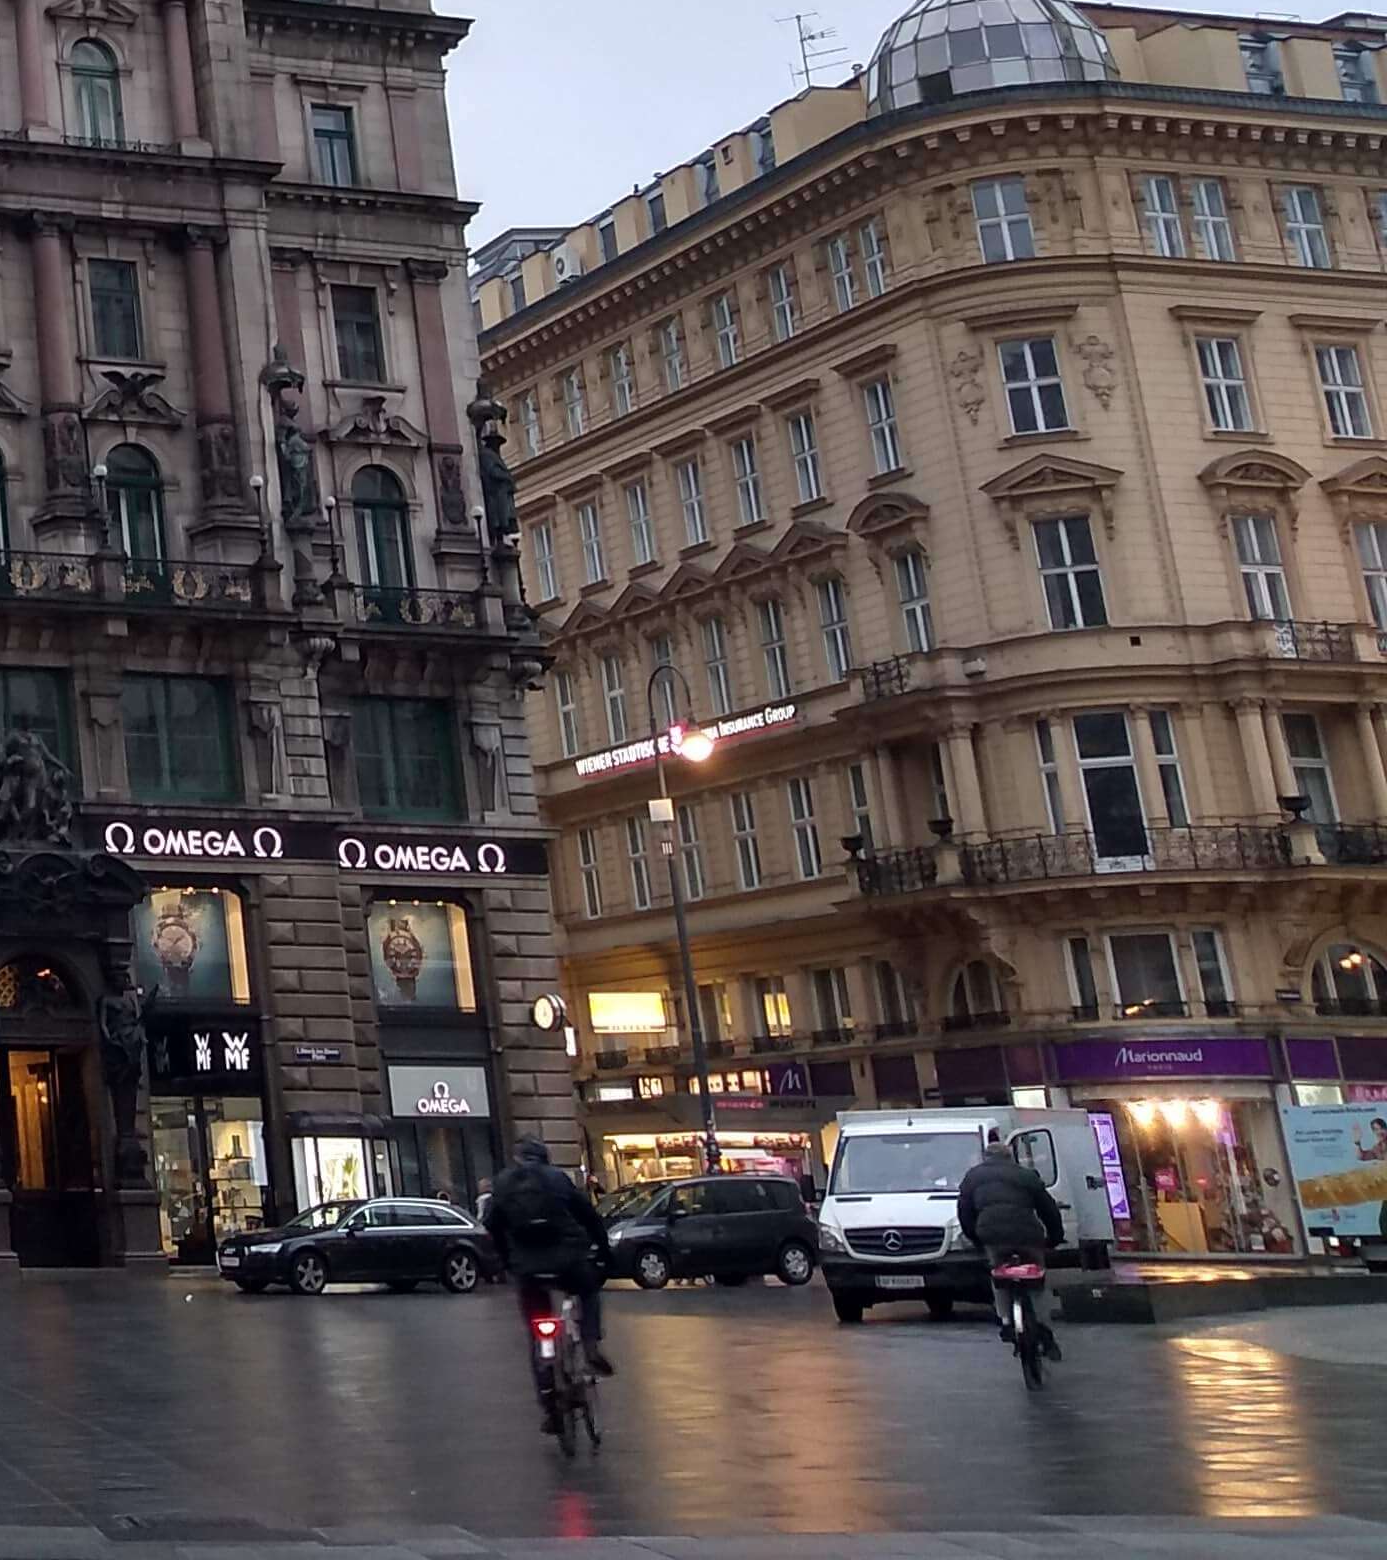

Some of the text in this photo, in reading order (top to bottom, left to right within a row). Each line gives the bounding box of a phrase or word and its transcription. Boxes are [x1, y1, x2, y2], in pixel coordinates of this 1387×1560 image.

[143, 828, 246, 857] OMEGA
[374, 844, 471, 873] OMEGA
[1114, 1047, 1204, 1068] Marionnaud
[417, 1098, 471, 1113] OMEGA
